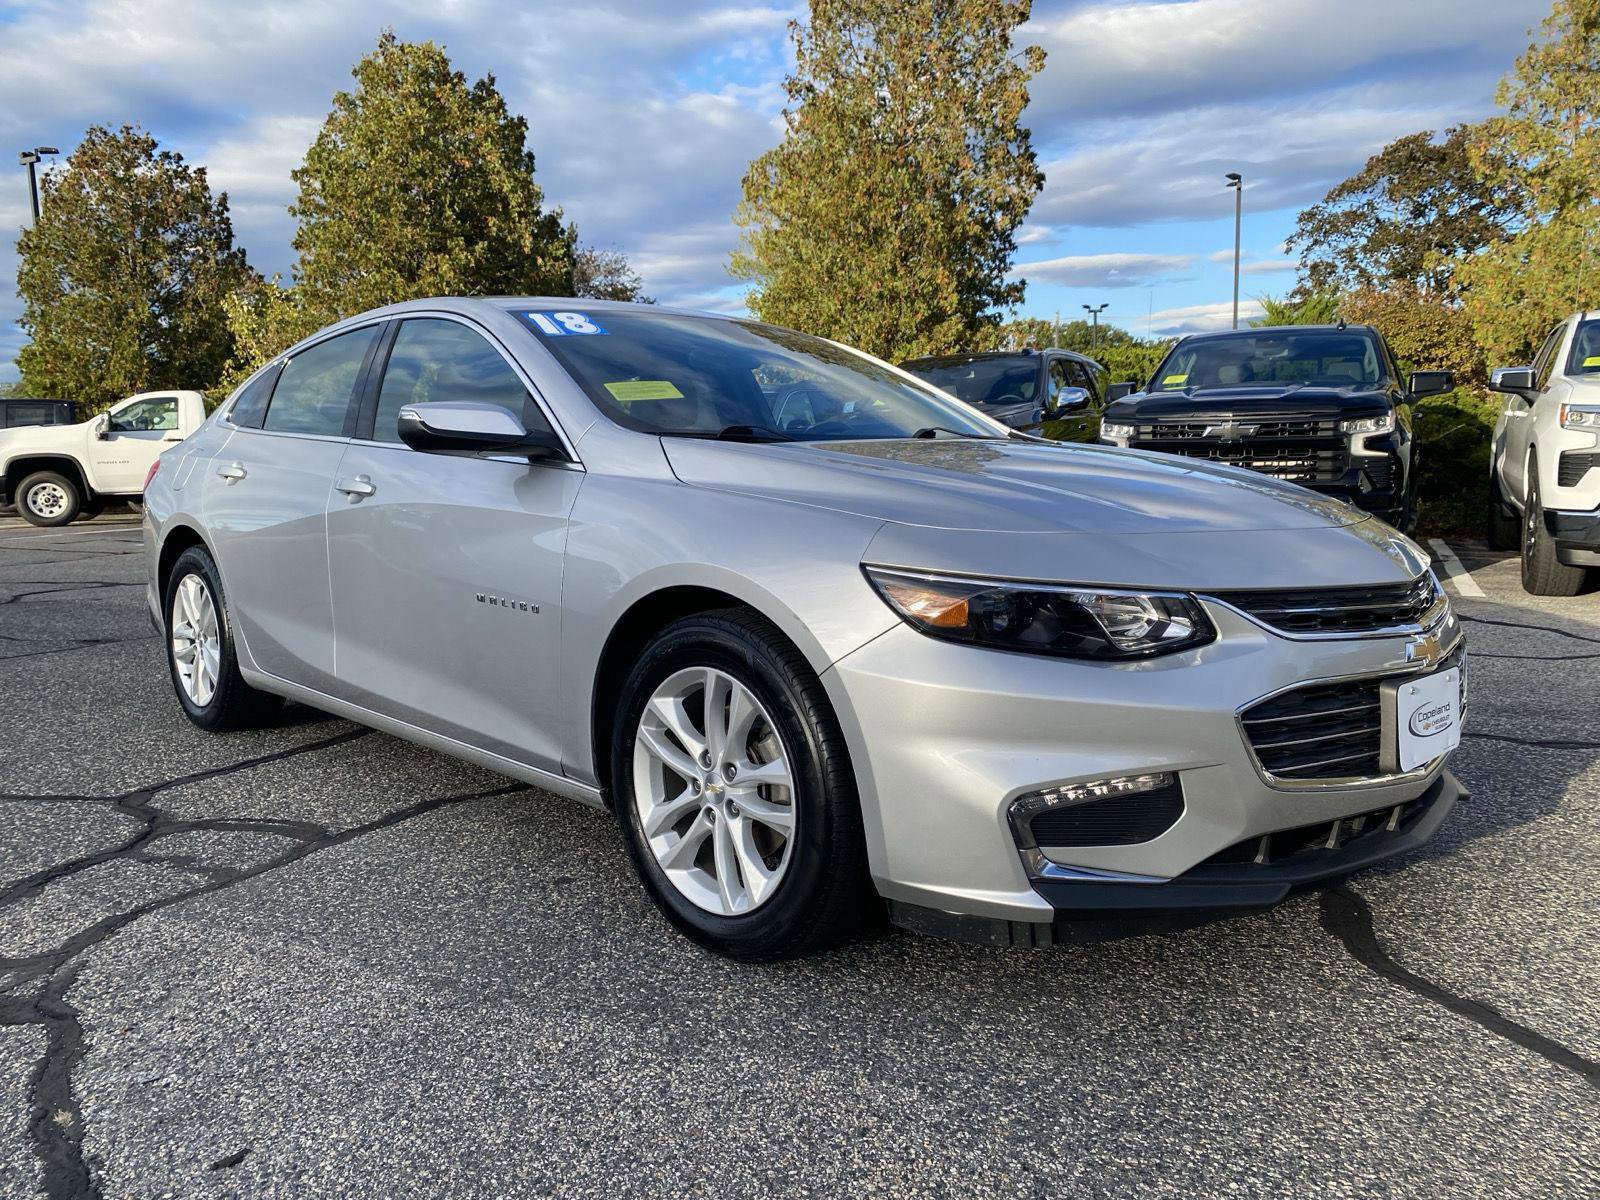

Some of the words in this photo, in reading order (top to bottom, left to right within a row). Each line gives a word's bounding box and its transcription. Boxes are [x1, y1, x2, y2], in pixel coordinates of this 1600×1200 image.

[528, 312, 601, 335] 18
[476, 593, 540, 614] MALIBU
[1417, 702, 1451, 722] Copeland
